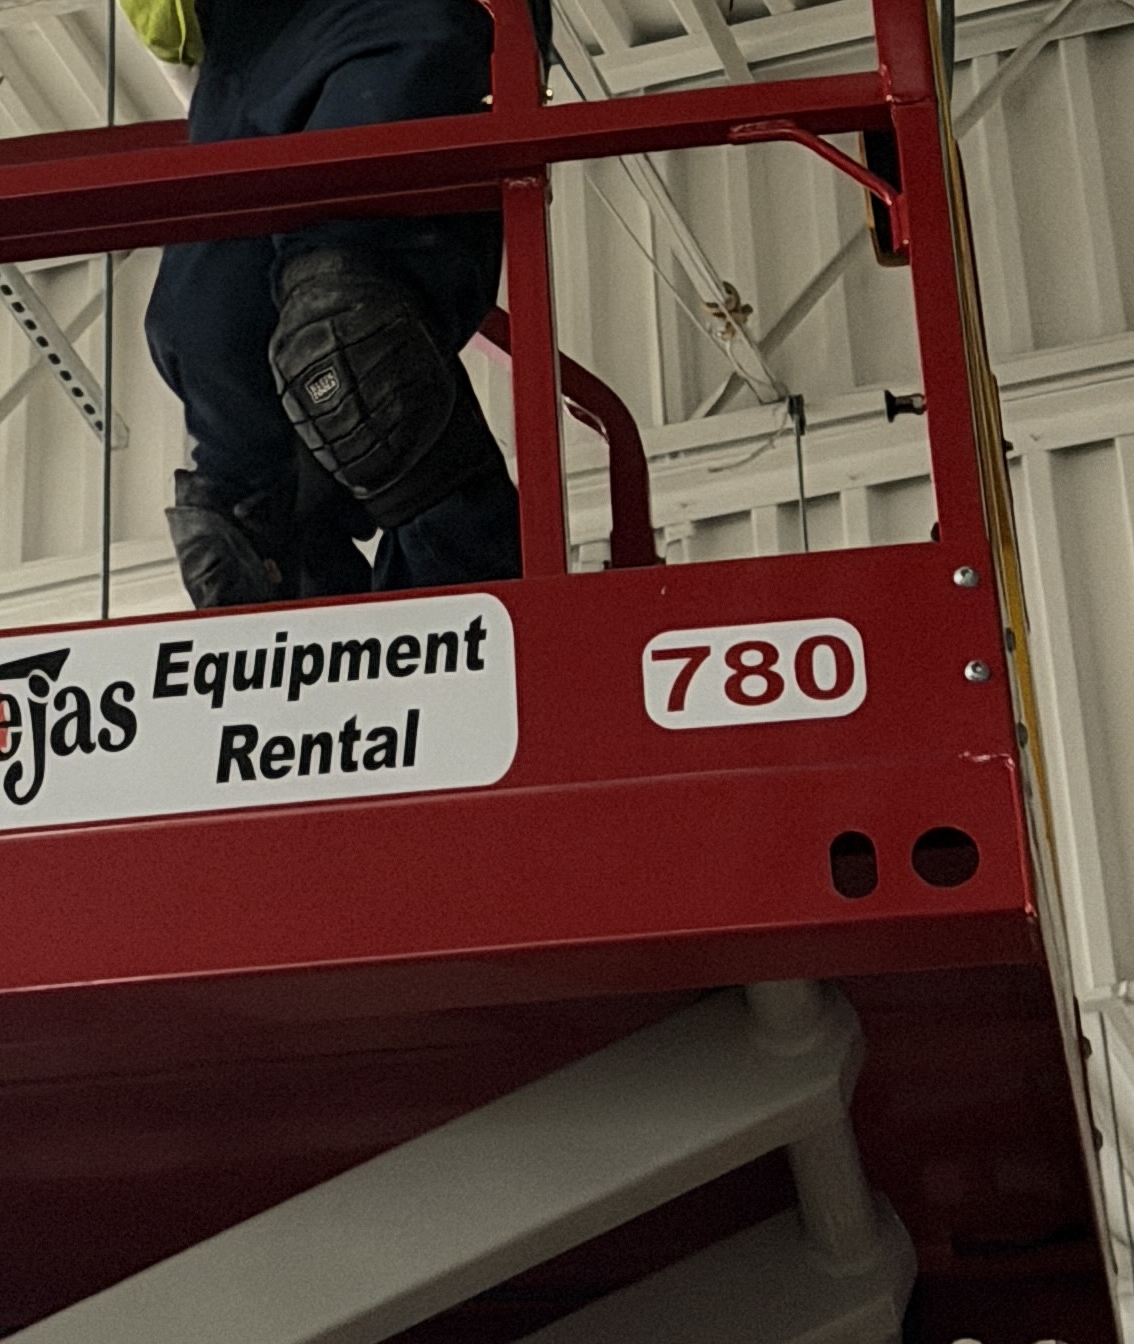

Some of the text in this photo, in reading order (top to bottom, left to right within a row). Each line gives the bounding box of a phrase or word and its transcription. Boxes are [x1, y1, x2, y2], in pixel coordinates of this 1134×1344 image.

[153, 615, 487, 709] Equipment
[651, 635, 855, 712] 780
[216, 709, 421, 784] Rental
